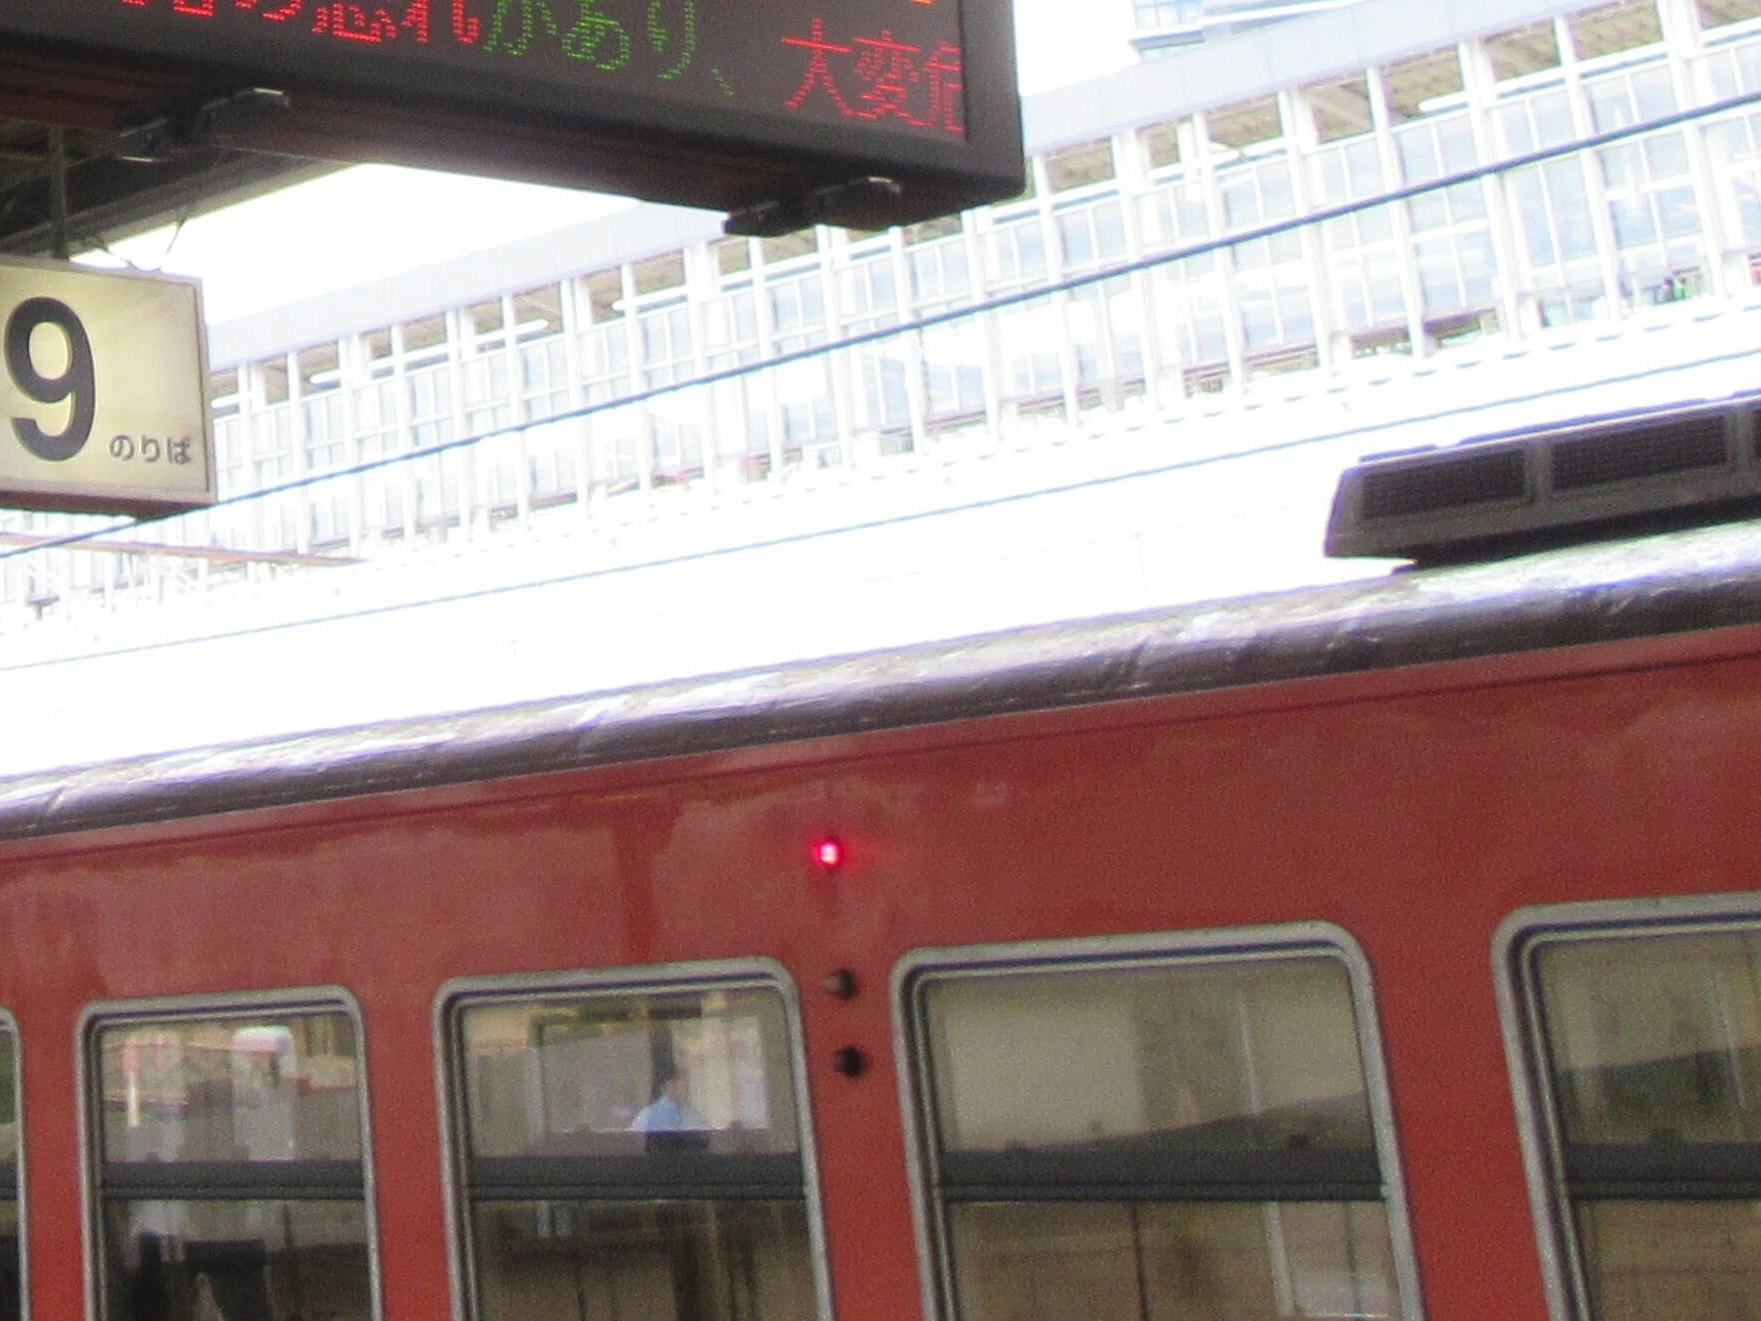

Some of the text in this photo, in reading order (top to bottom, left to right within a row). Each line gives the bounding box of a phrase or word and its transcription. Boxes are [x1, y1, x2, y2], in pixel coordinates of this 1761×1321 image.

[3, 295, 96, 463] 9
[108, 434, 193, 465] のりば
